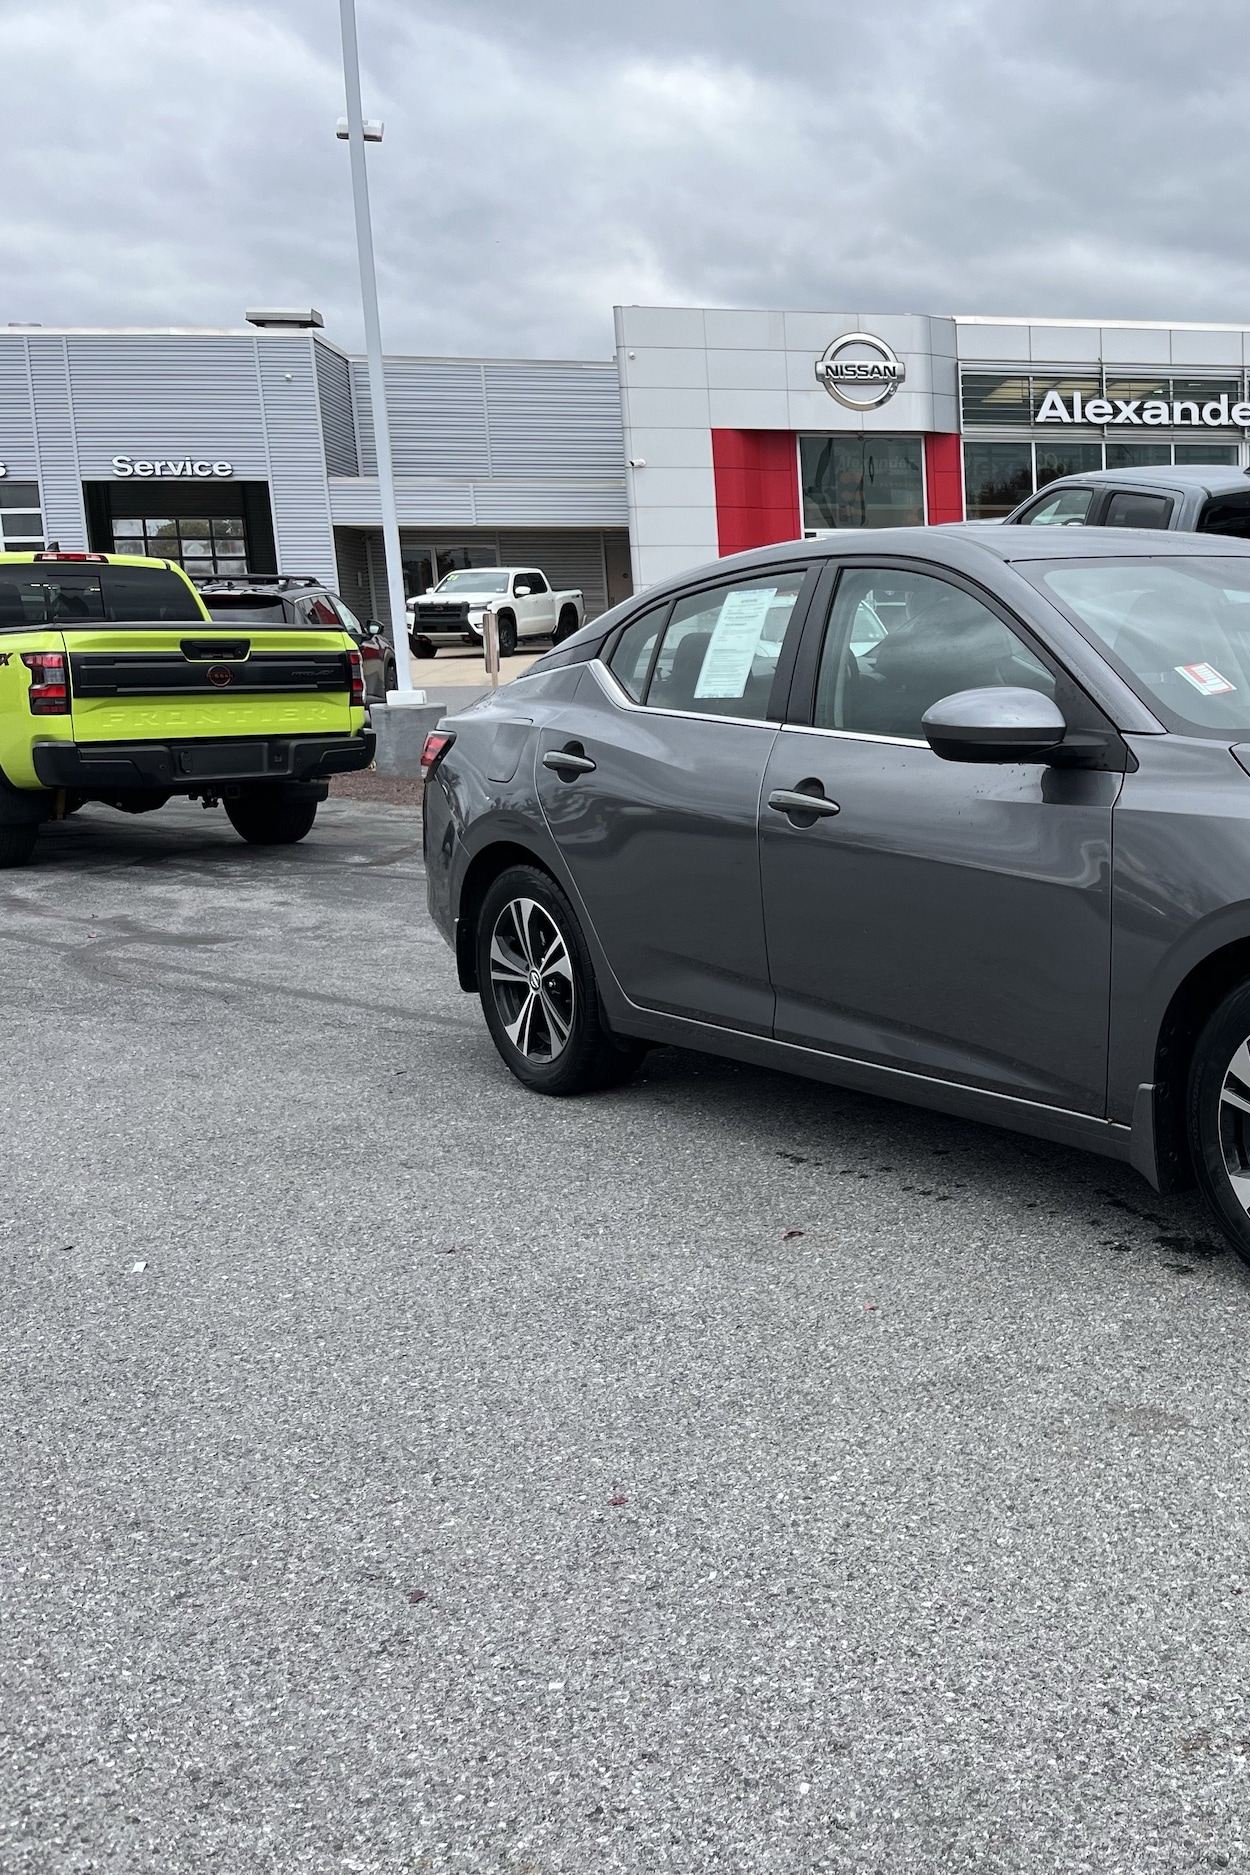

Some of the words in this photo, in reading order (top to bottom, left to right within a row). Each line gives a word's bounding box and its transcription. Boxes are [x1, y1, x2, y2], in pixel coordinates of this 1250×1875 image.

[825, 364, 896, 379] NISSAN
[111, 456, 233, 477] Service
[102, 706, 328, 727] FRONTIER
